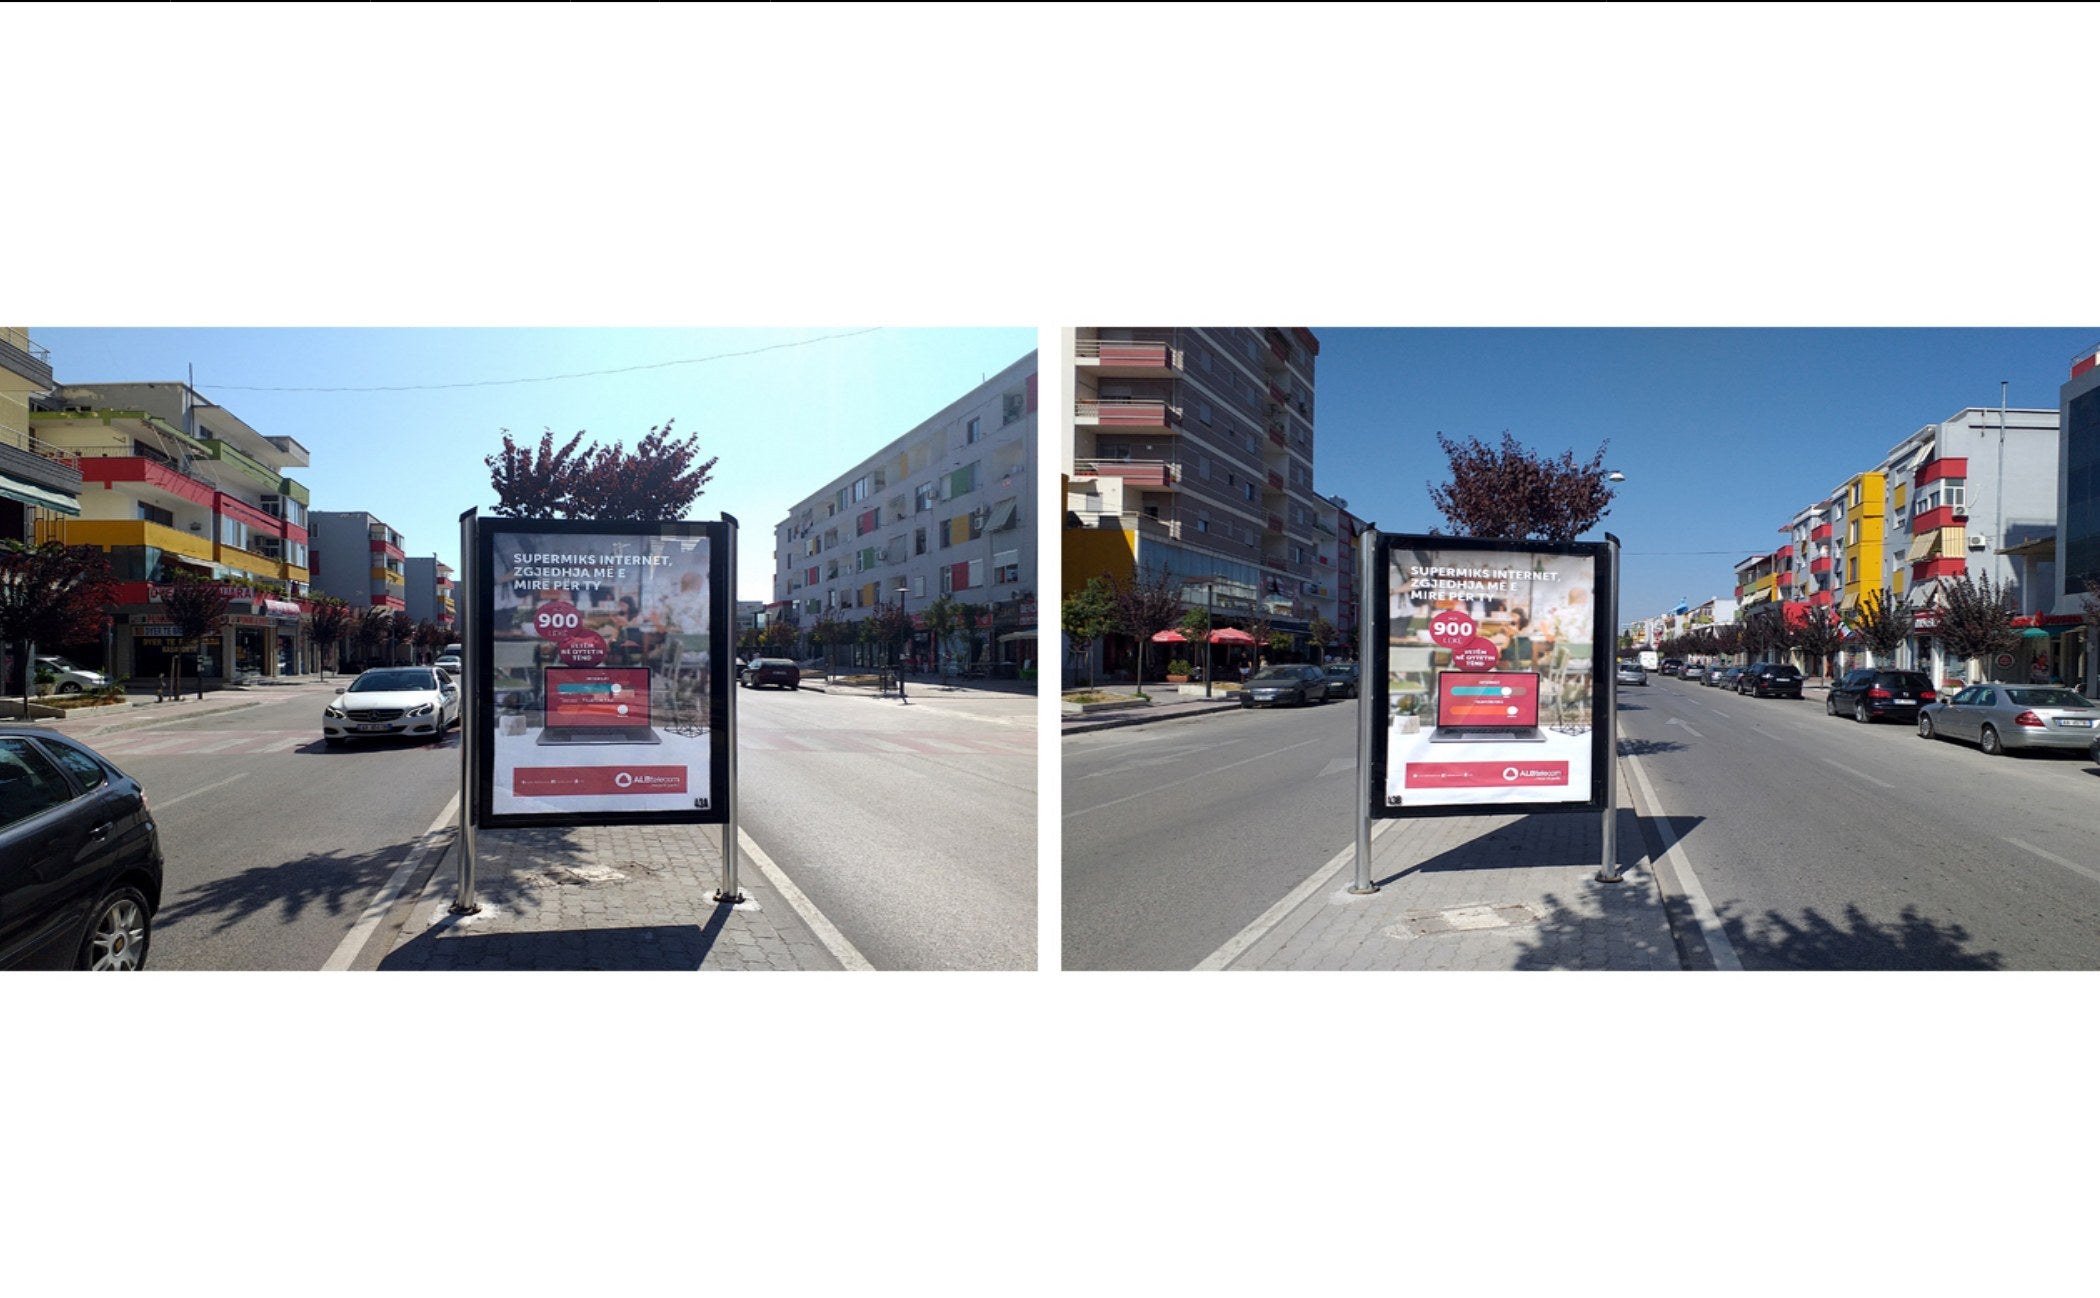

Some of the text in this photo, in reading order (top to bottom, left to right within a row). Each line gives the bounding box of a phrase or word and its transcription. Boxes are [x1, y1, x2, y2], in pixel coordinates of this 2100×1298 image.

[513, 553, 673, 567] SUPERMIKS INTERNET,
[513, 566, 590, 578] ZGJEDHJA
[618, 568, 626, 578] E
[1410, 566, 1561, 582] SUPERMIKS INTERNET,
[581, 580, 601, 591] TY
[1410, 578, 1484, 589] ZGJEDHJA
[1511, 581, 1518, 591] E
[1479, 593, 1495, 602] TY
[538, 613, 579, 628] 900
[1433, 622, 1473, 636] 900
